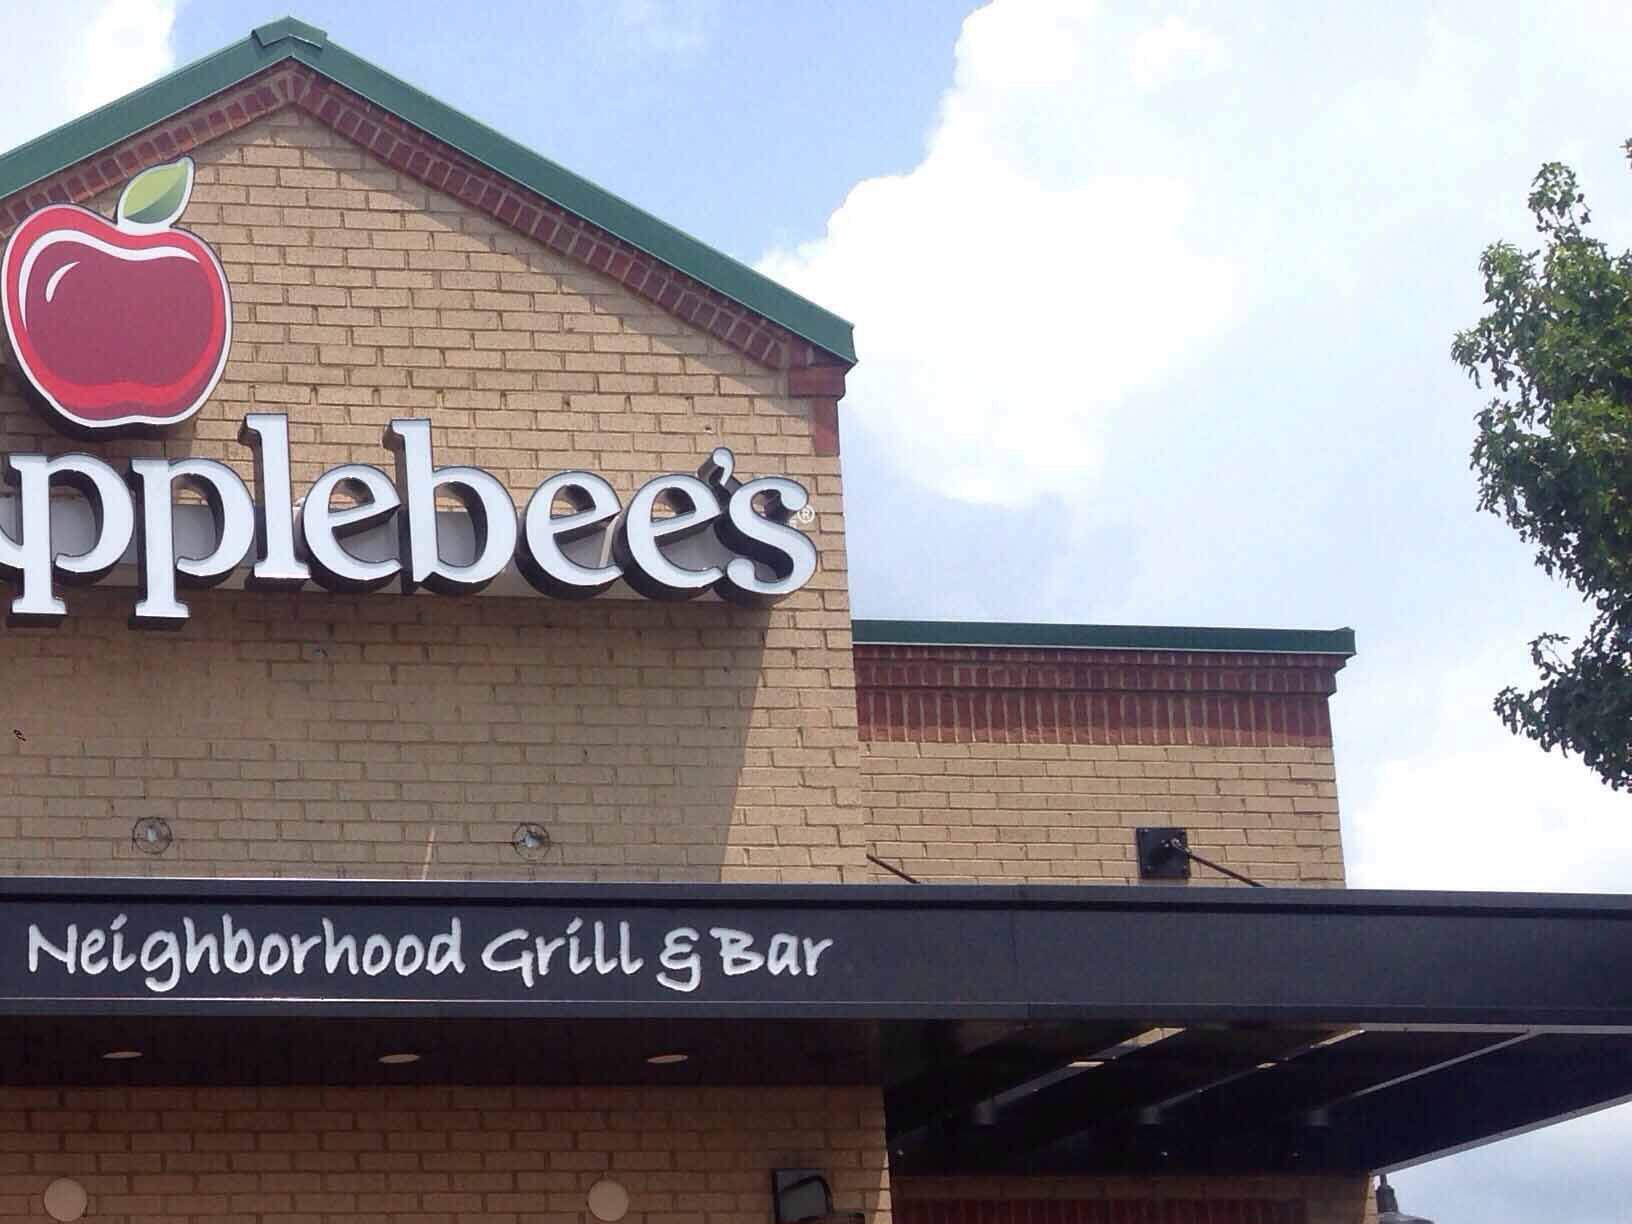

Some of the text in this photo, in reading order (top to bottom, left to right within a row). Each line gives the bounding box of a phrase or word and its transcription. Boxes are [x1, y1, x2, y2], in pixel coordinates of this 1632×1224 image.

[28, 912, 834, 993] Neighborhood Grill & Bar
